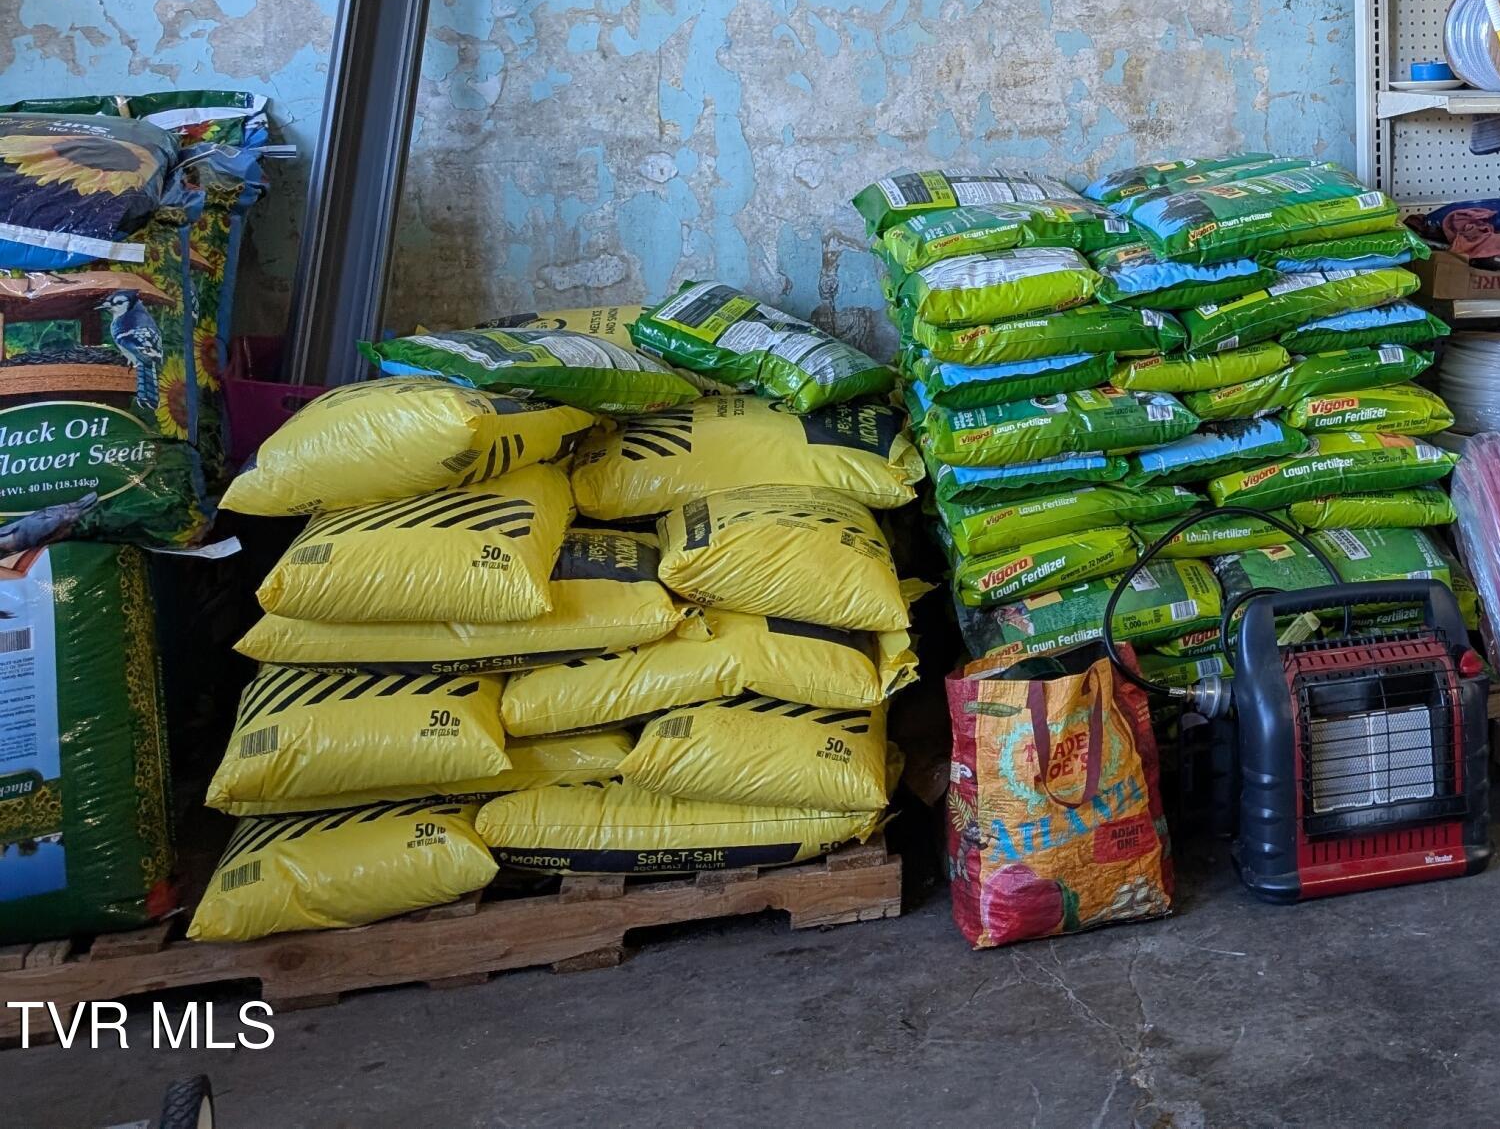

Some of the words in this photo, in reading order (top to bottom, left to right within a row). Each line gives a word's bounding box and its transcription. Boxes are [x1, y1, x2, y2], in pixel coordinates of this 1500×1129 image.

[1189, 223, 1218, 241] Vigoro
[1218, 218, 1239, 229] Lawn
[1240, 211, 1273, 225] Fertilizer
[932, 236, 960, 251] Vigoro
[963, 229, 984, 239] Lawn
[985, 222, 1019, 236] Fertilizer
[607, 308, 619, 322] SNOW
[589, 317, 602, 334] MELTS
[605, 322, 616, 335] AND
[959, 327, 987, 343] Vigoro
[1013, 319, 1049, 331] Fertilizer
[1132, 356, 1162, 371] Vigoro
[1216, 386, 1242, 400] Vigoro
[1309, 397, 1357, 416] Vigoro
[1315, 412, 1343, 427] Lawn
[1344, 406, 1388, 423] Fertilizer
[1402, 420, 1410, 429] 72
[0, 421, 56, 448] lack
[64, 416, 110, 440] Oil
[960, 430, 991, 445] Vigoro
[993, 423, 1016, 435] Lawn
[1017, 416, 1053, 430] Fertilizer
[1243, 466, 1277, 487] Vigoro
[1283, 463, 1311, 479] Lawn
[1312, 457, 1355, 474] Fertilizer
[7, 486, 26, 496] Wt.
[28, 483, 41, 493] 40
[42, 482, 53, 492] lb
[55, 477, 100, 491] (18.14kg)
[986, 508, 1014, 525] Vigoro
[1018, 504, 1042, 516] Lawn
[1043, 495, 1079, 510] Fertilizer
[1187, 531, 1211, 543] Lawn
[1212, 526, 1252, 540] Fertilizer
[481, 544, 502, 560] 50
[502, 551, 512, 563] lb
[471, 559, 480, 568] NET
[481, 560, 488, 569] WT
[980, 558, 1030, 589] Vigoro
[1060, 565, 1080, 581] Greens
[1089, 560, 1096, 570] 72
[1097, 551, 1114, 566] hours!
[990, 580, 1020, 601] Lawn
[1021, 555, 1067, 581] Fertilizer
[1123, 620, 1142, 630] 5,000
[1376, 608, 1419, 624] Fertilizer
[1026, 638, 1056, 654] Lawn
[1057, 627, 1103, 647] Fertilizer
[431, 655, 526, 674] Safe-T-Salt
[429, 709, 451, 727] 50
[451, 717, 461, 728] lb
[420, 728, 430, 737] NET
[430, 728, 438, 737] WT
[815, 750, 825, 759] NET
[825, 751, 832, 760] WT
[825, 736, 844, 754] 50
[844, 747, 853, 756] lb
[987, 774, 1143, 864] ATLANTA
[414, 822, 436, 839] 50
[436, 825, 446, 835] lb
[1110, 823, 1145, 841] ADMIT
[407, 840, 417, 849] NET
[417, 839, 425, 848] WT
[1116, 836, 1140, 850] ONE
[510, 854, 571, 868] MORTON
[636, 849, 725, 866] Safe-T-Salt
